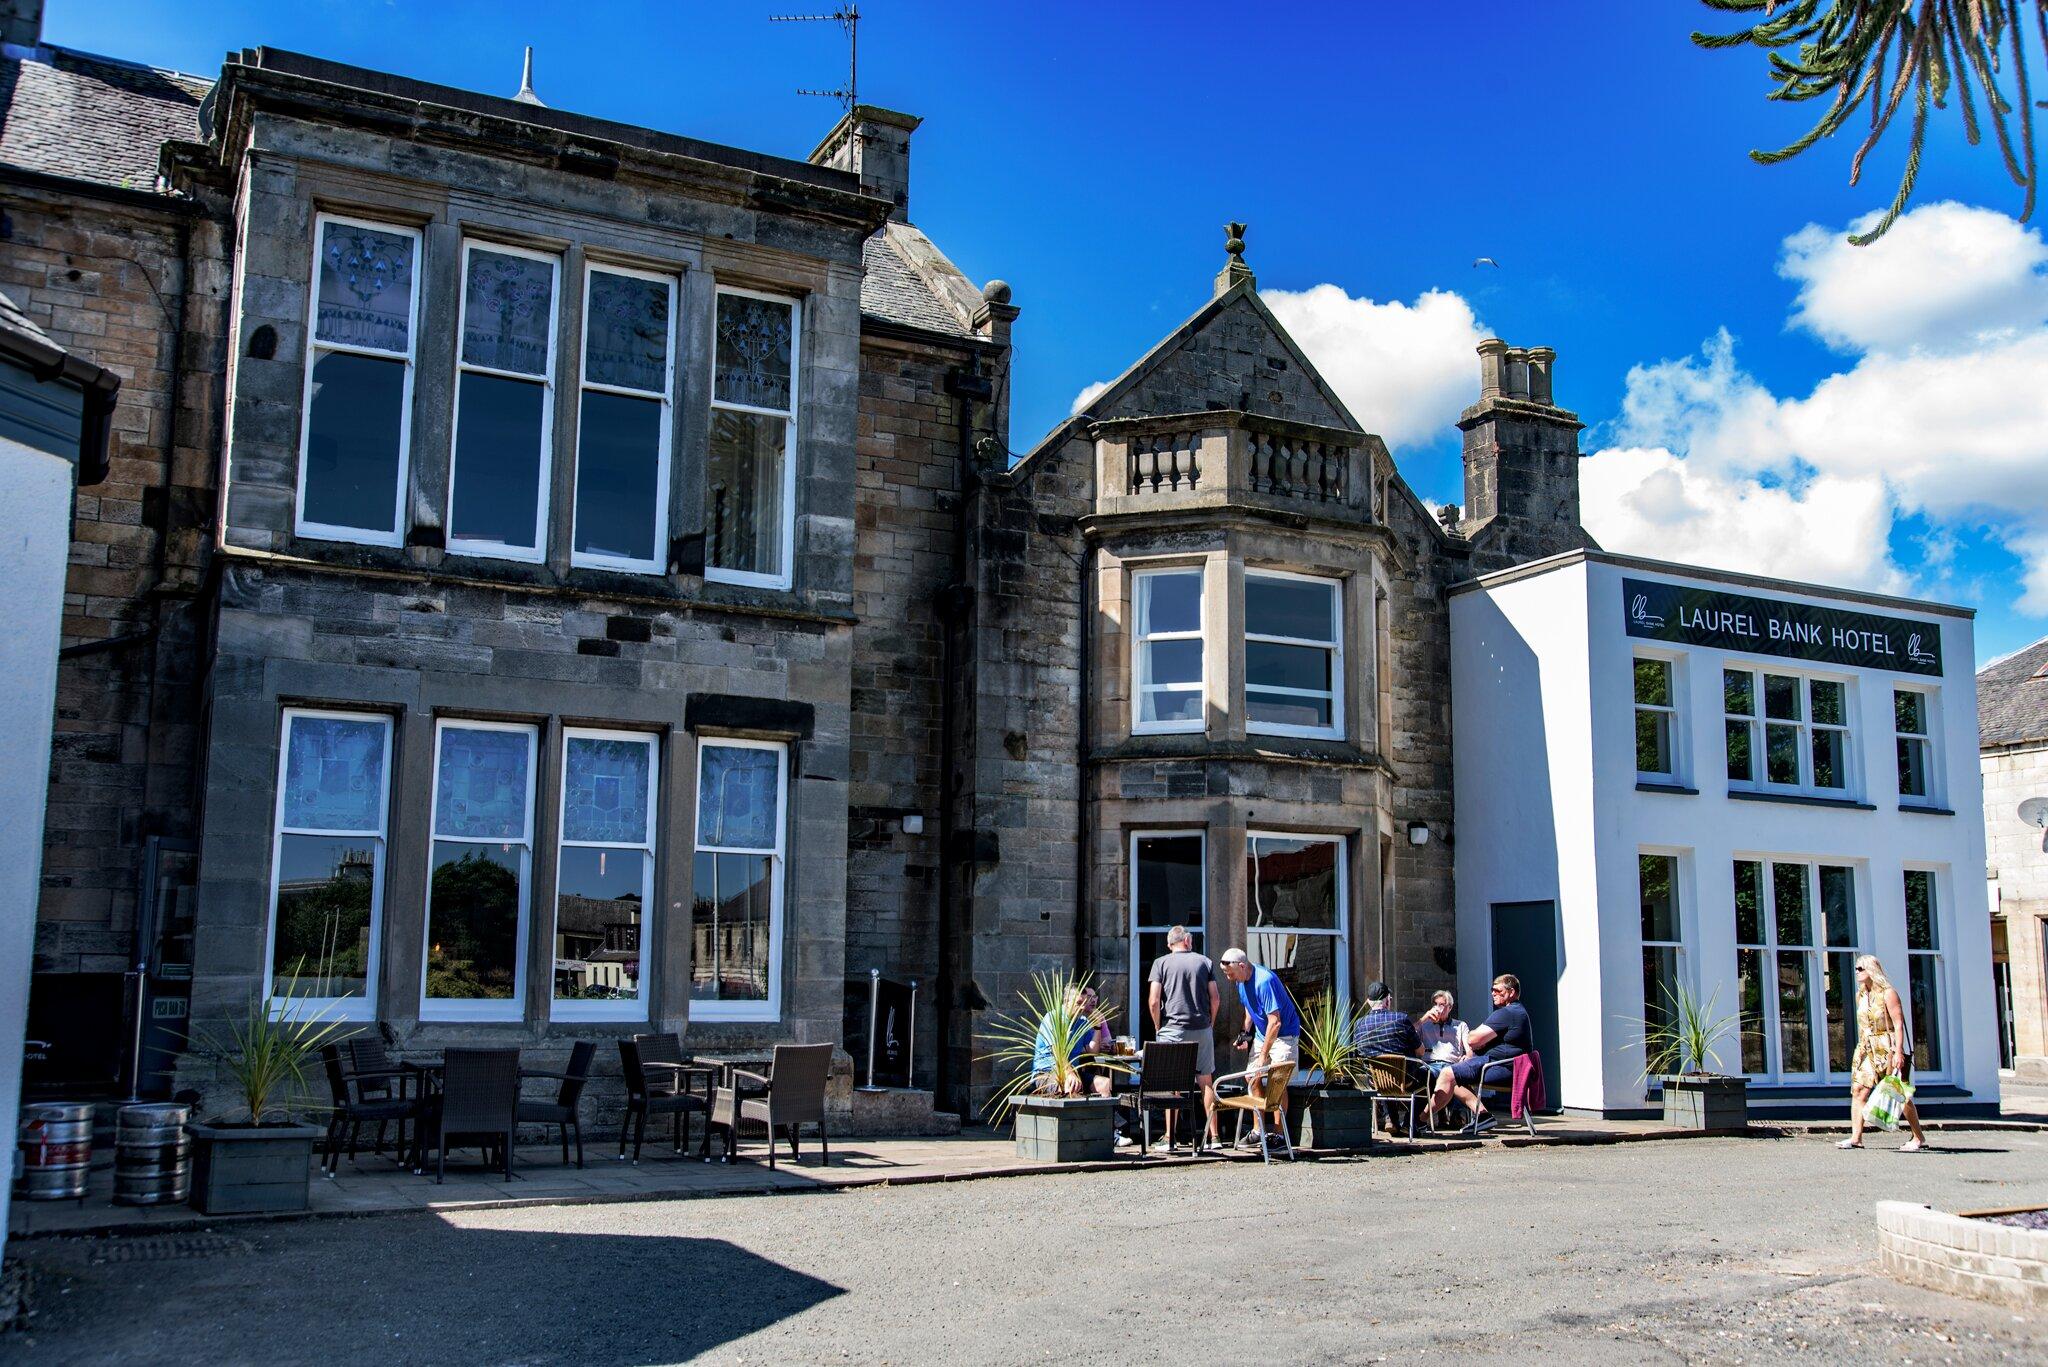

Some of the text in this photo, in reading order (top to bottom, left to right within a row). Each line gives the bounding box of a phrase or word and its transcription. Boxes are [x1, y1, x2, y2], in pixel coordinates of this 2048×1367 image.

[1680, 605, 1895, 655] LAUREL BANK HOTEL
